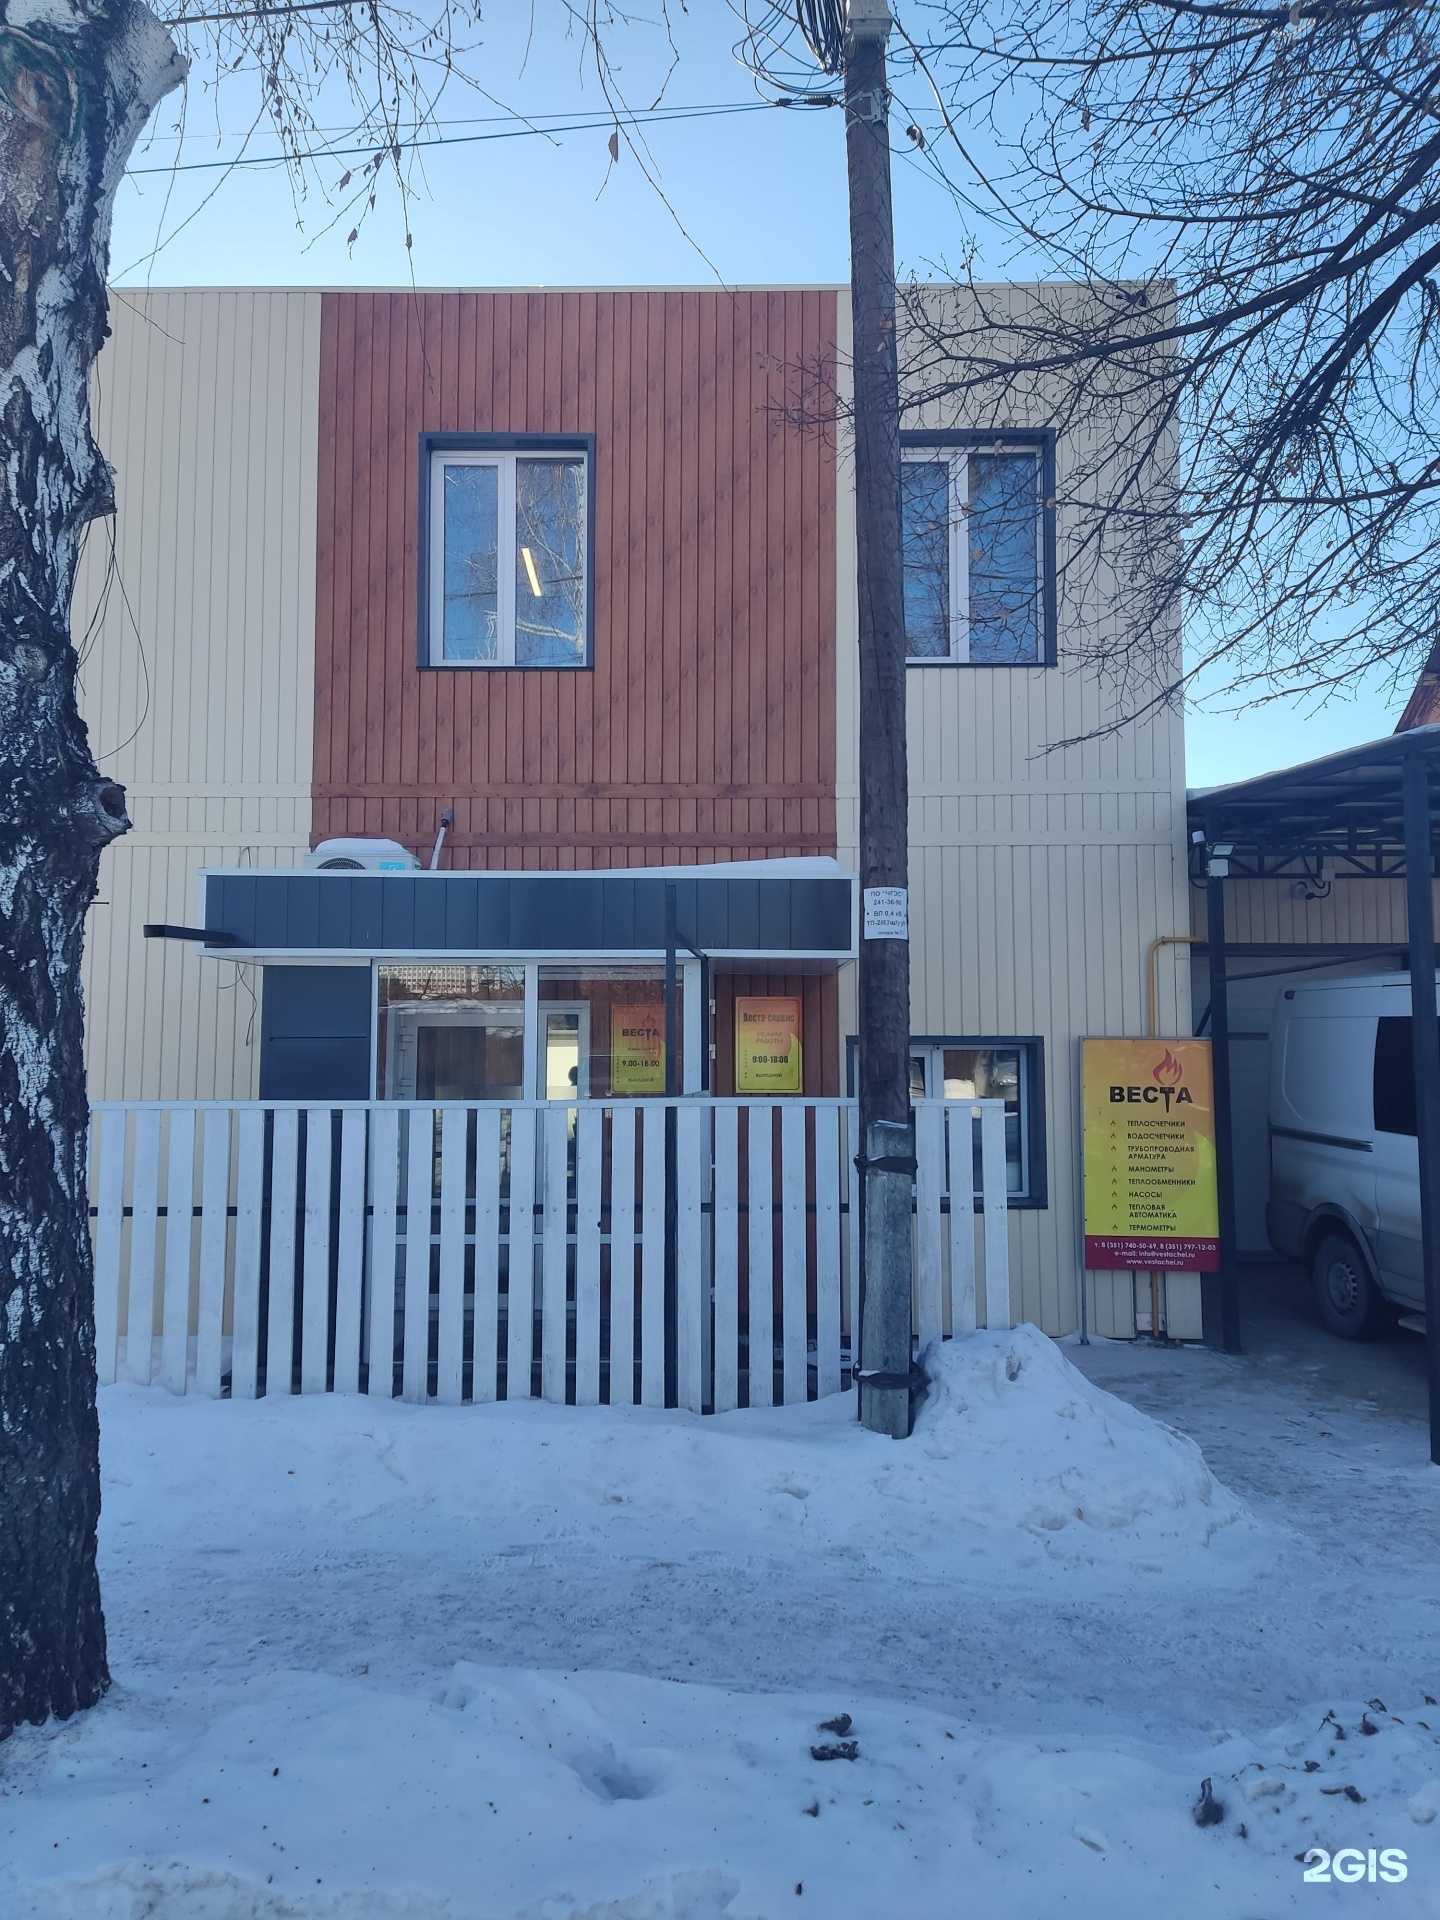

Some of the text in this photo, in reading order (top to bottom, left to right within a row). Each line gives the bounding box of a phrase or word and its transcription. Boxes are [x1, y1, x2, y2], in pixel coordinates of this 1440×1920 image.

[622, 1028, 660, 1040] ВЕСТА
[1109, 1086, 1193, 1113] ВЕСТА
[1128, 1178, 1196, 1186] ТЕПЛООБМЕННИКИ
[1129, 1211, 1177, 1219] АВТОМАТИКА
[1129, 1224, 1176, 1232] ТЕРМОМЕТРЫ
